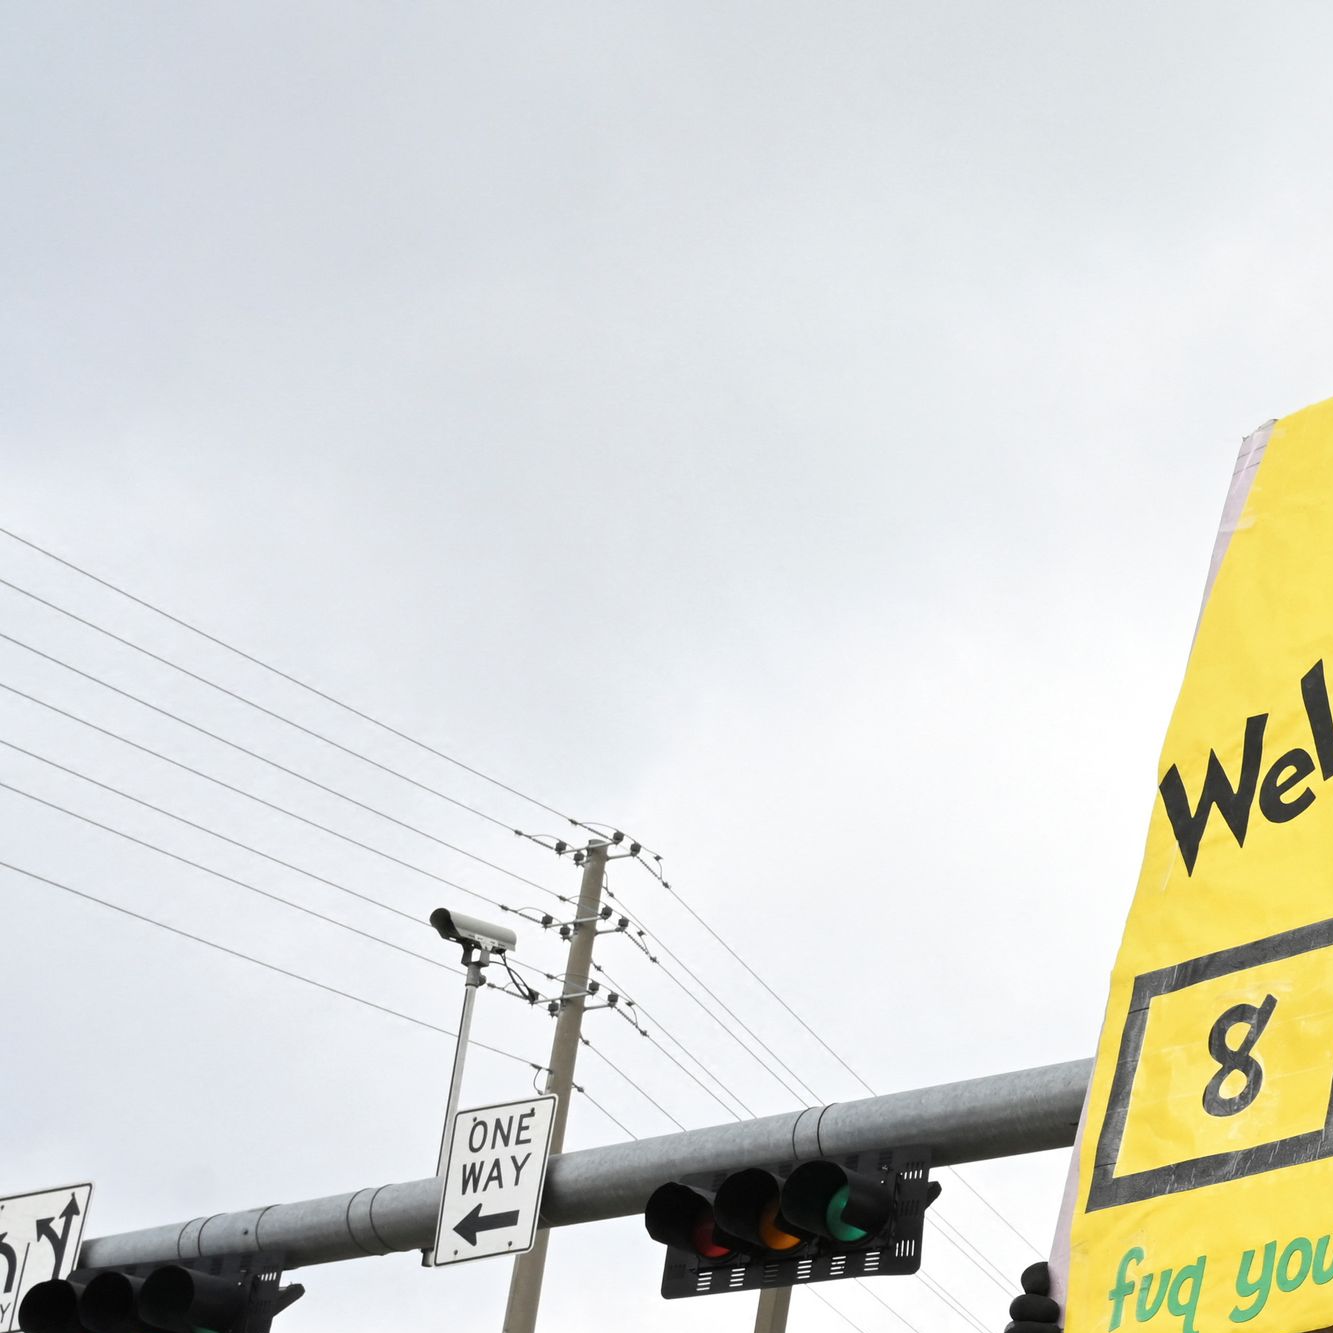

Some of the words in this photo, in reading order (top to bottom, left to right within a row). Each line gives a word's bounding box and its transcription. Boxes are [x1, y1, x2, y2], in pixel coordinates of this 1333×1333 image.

[1202, 993, 1277, 1117] 8
[468, 1111, 534, 1153] ONE
[461, 1152, 532, 1196] WAY
